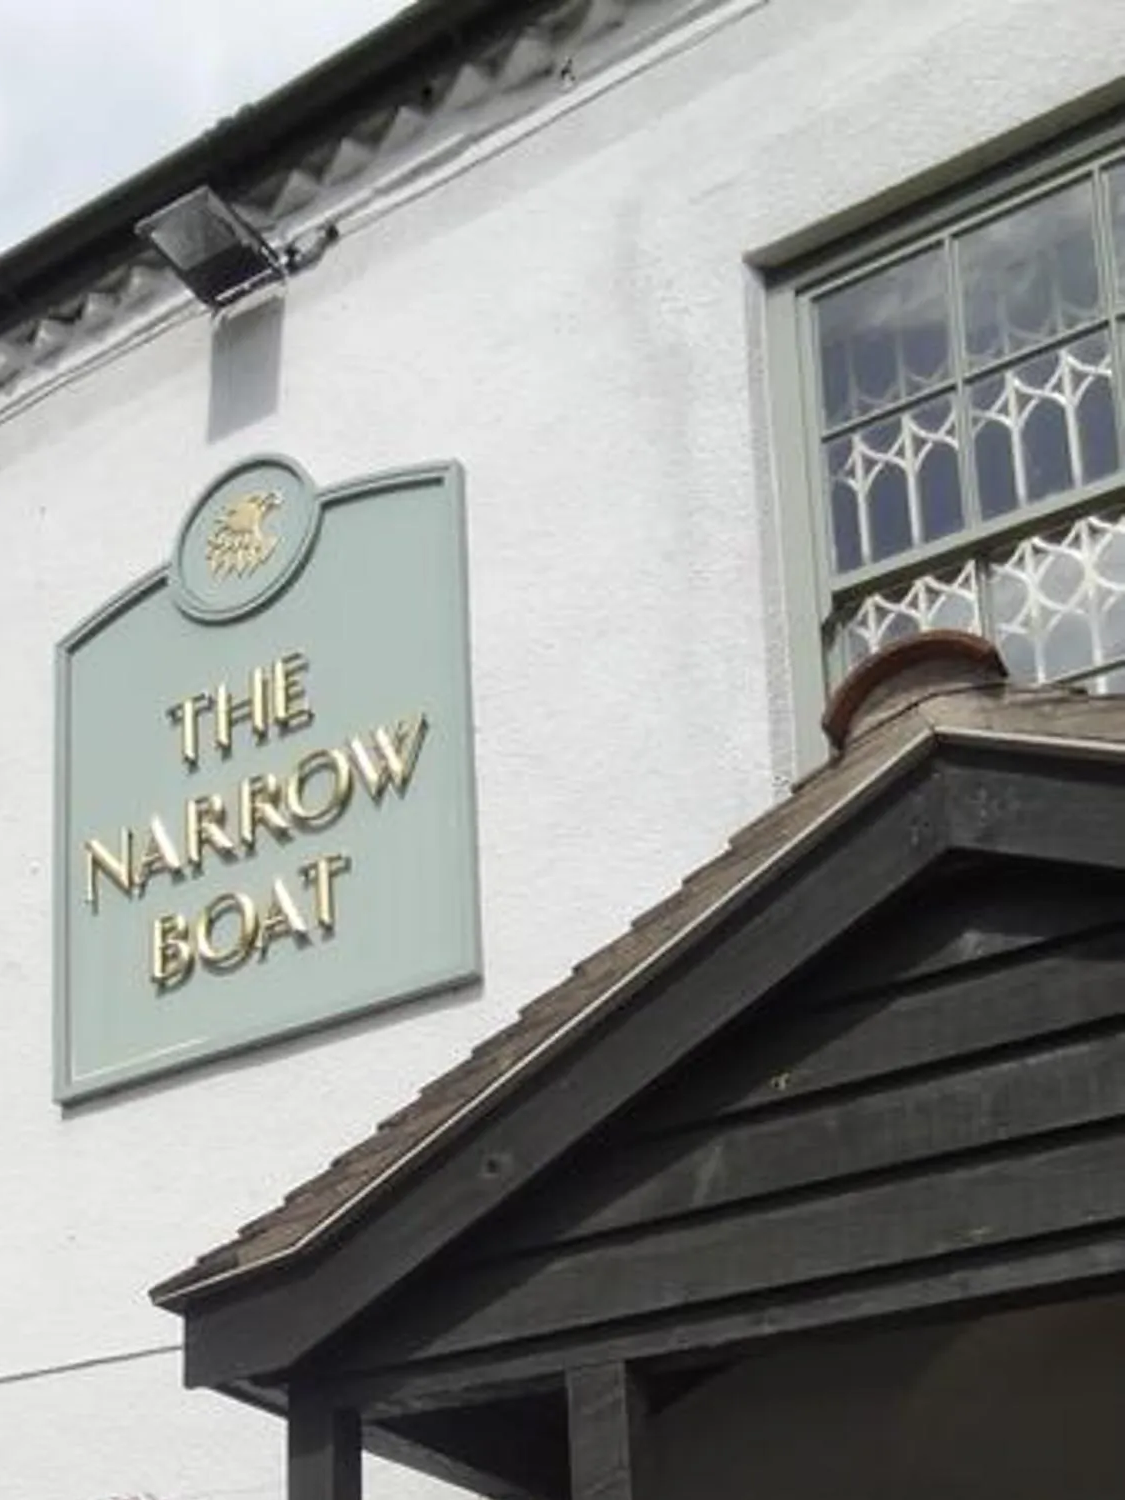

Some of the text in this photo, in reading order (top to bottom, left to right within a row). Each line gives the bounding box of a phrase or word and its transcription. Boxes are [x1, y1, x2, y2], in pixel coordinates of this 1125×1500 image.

[168, 653, 313, 769] THE
[83, 712, 428, 911] NARROW
[151, 853, 350, 993] BOAT
